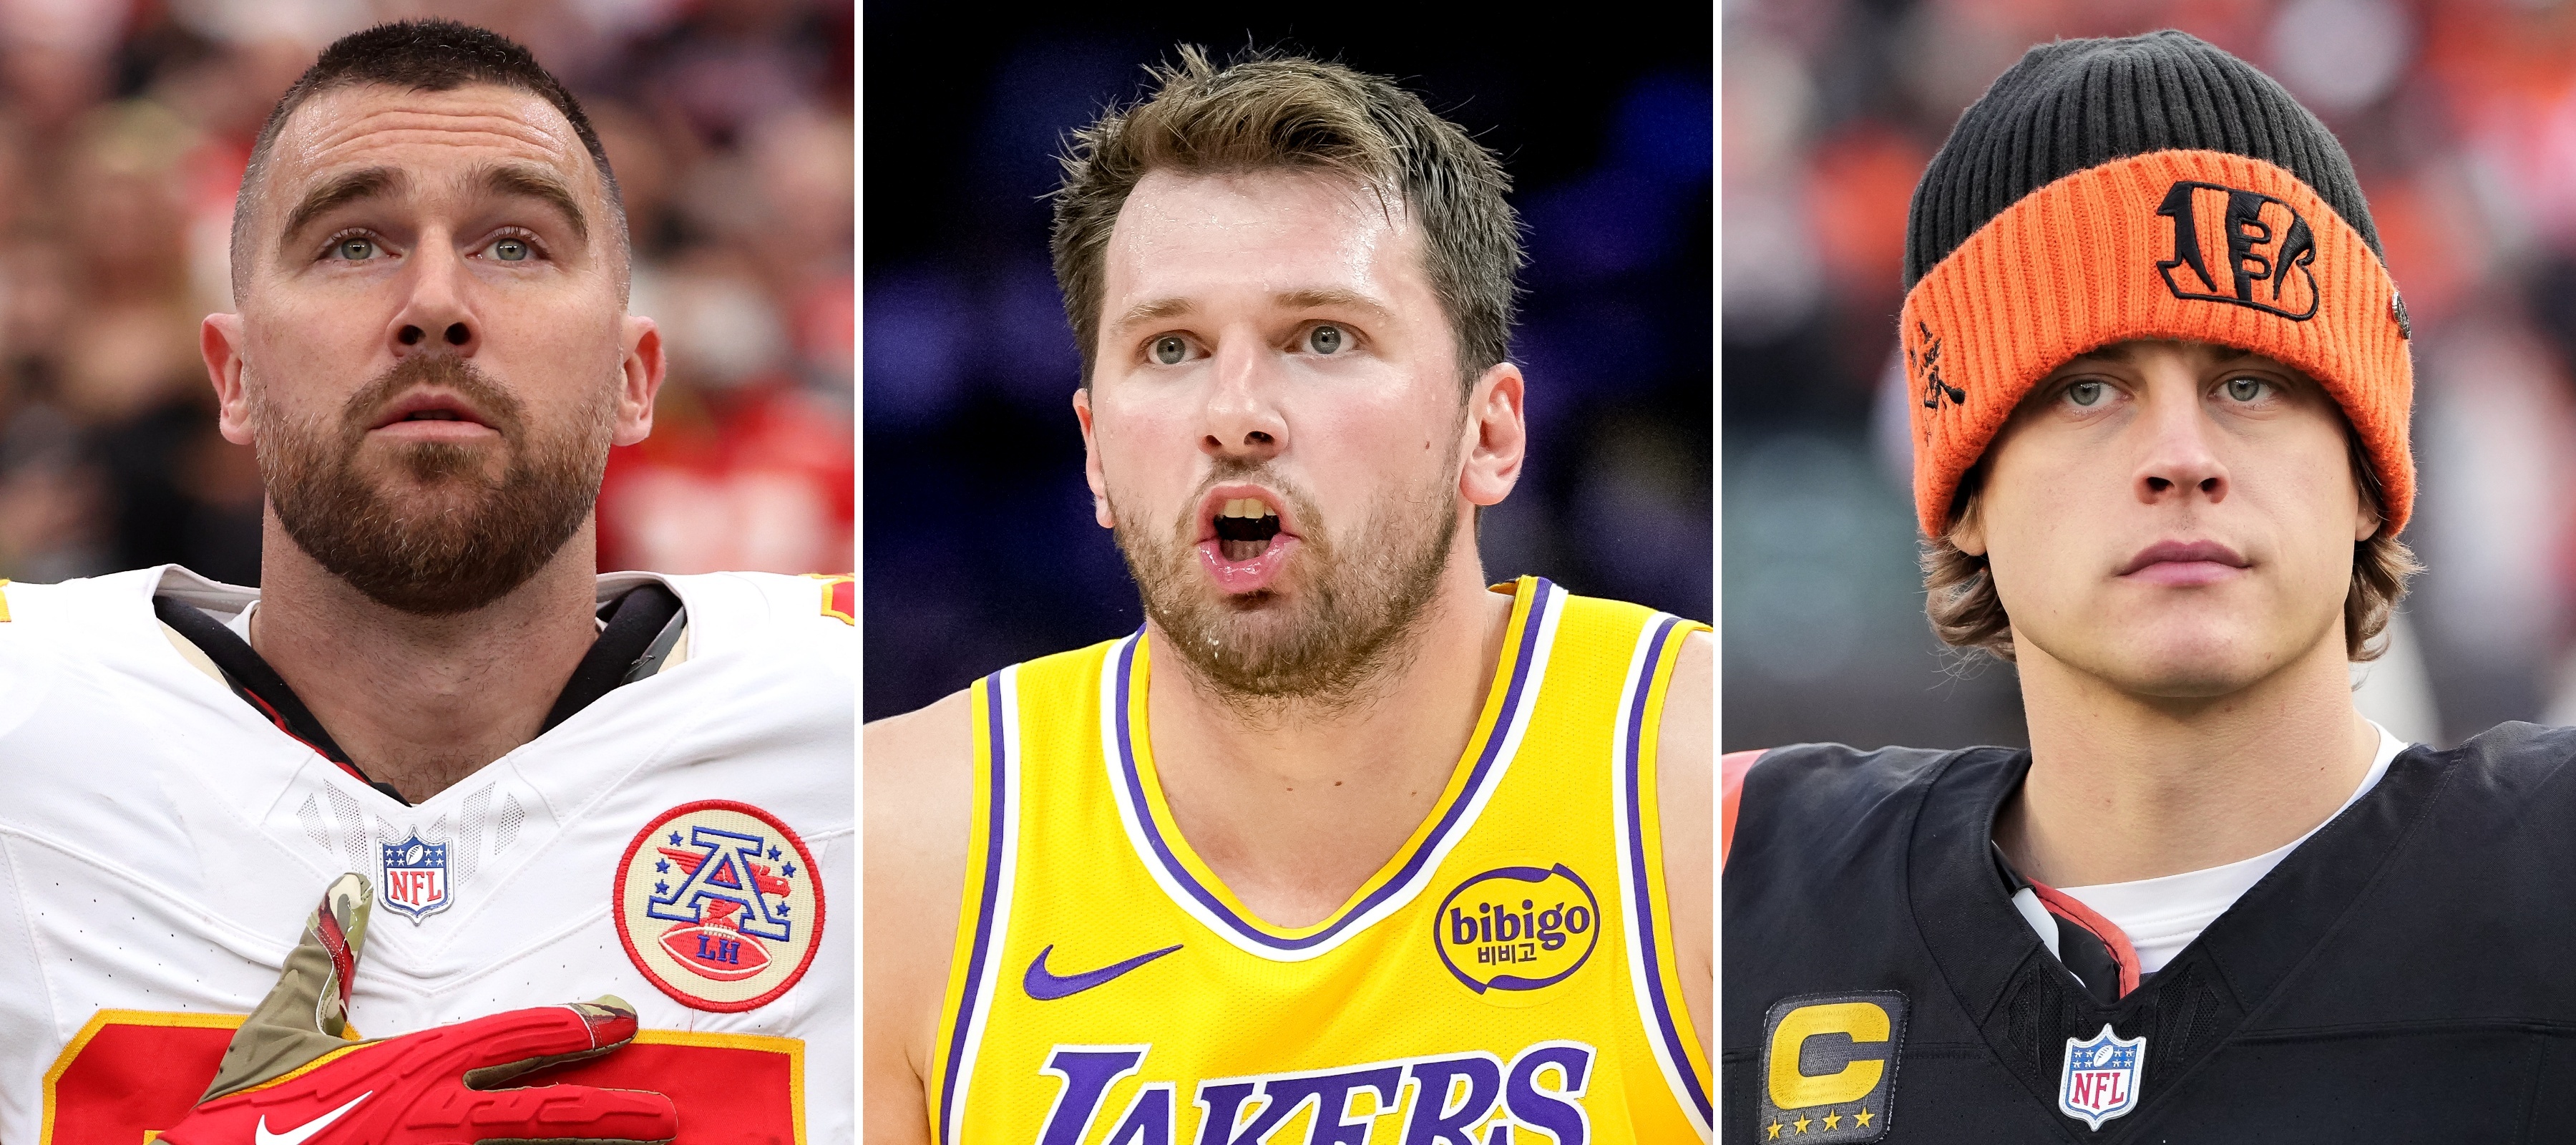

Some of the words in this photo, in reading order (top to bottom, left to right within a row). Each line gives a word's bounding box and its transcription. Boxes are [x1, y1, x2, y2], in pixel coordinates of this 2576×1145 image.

[390, 869, 442, 905] NFL
[1450, 899, 1590, 950] bibigo
[696, 935, 739, 964] LH
[1478, 942, 1536, 965] 비비고
[1768, 1002, 1890, 1110] C
[1038, 1040, 1599, 1145] LAKERS
[2072, 1071, 2124, 1110] NFL
